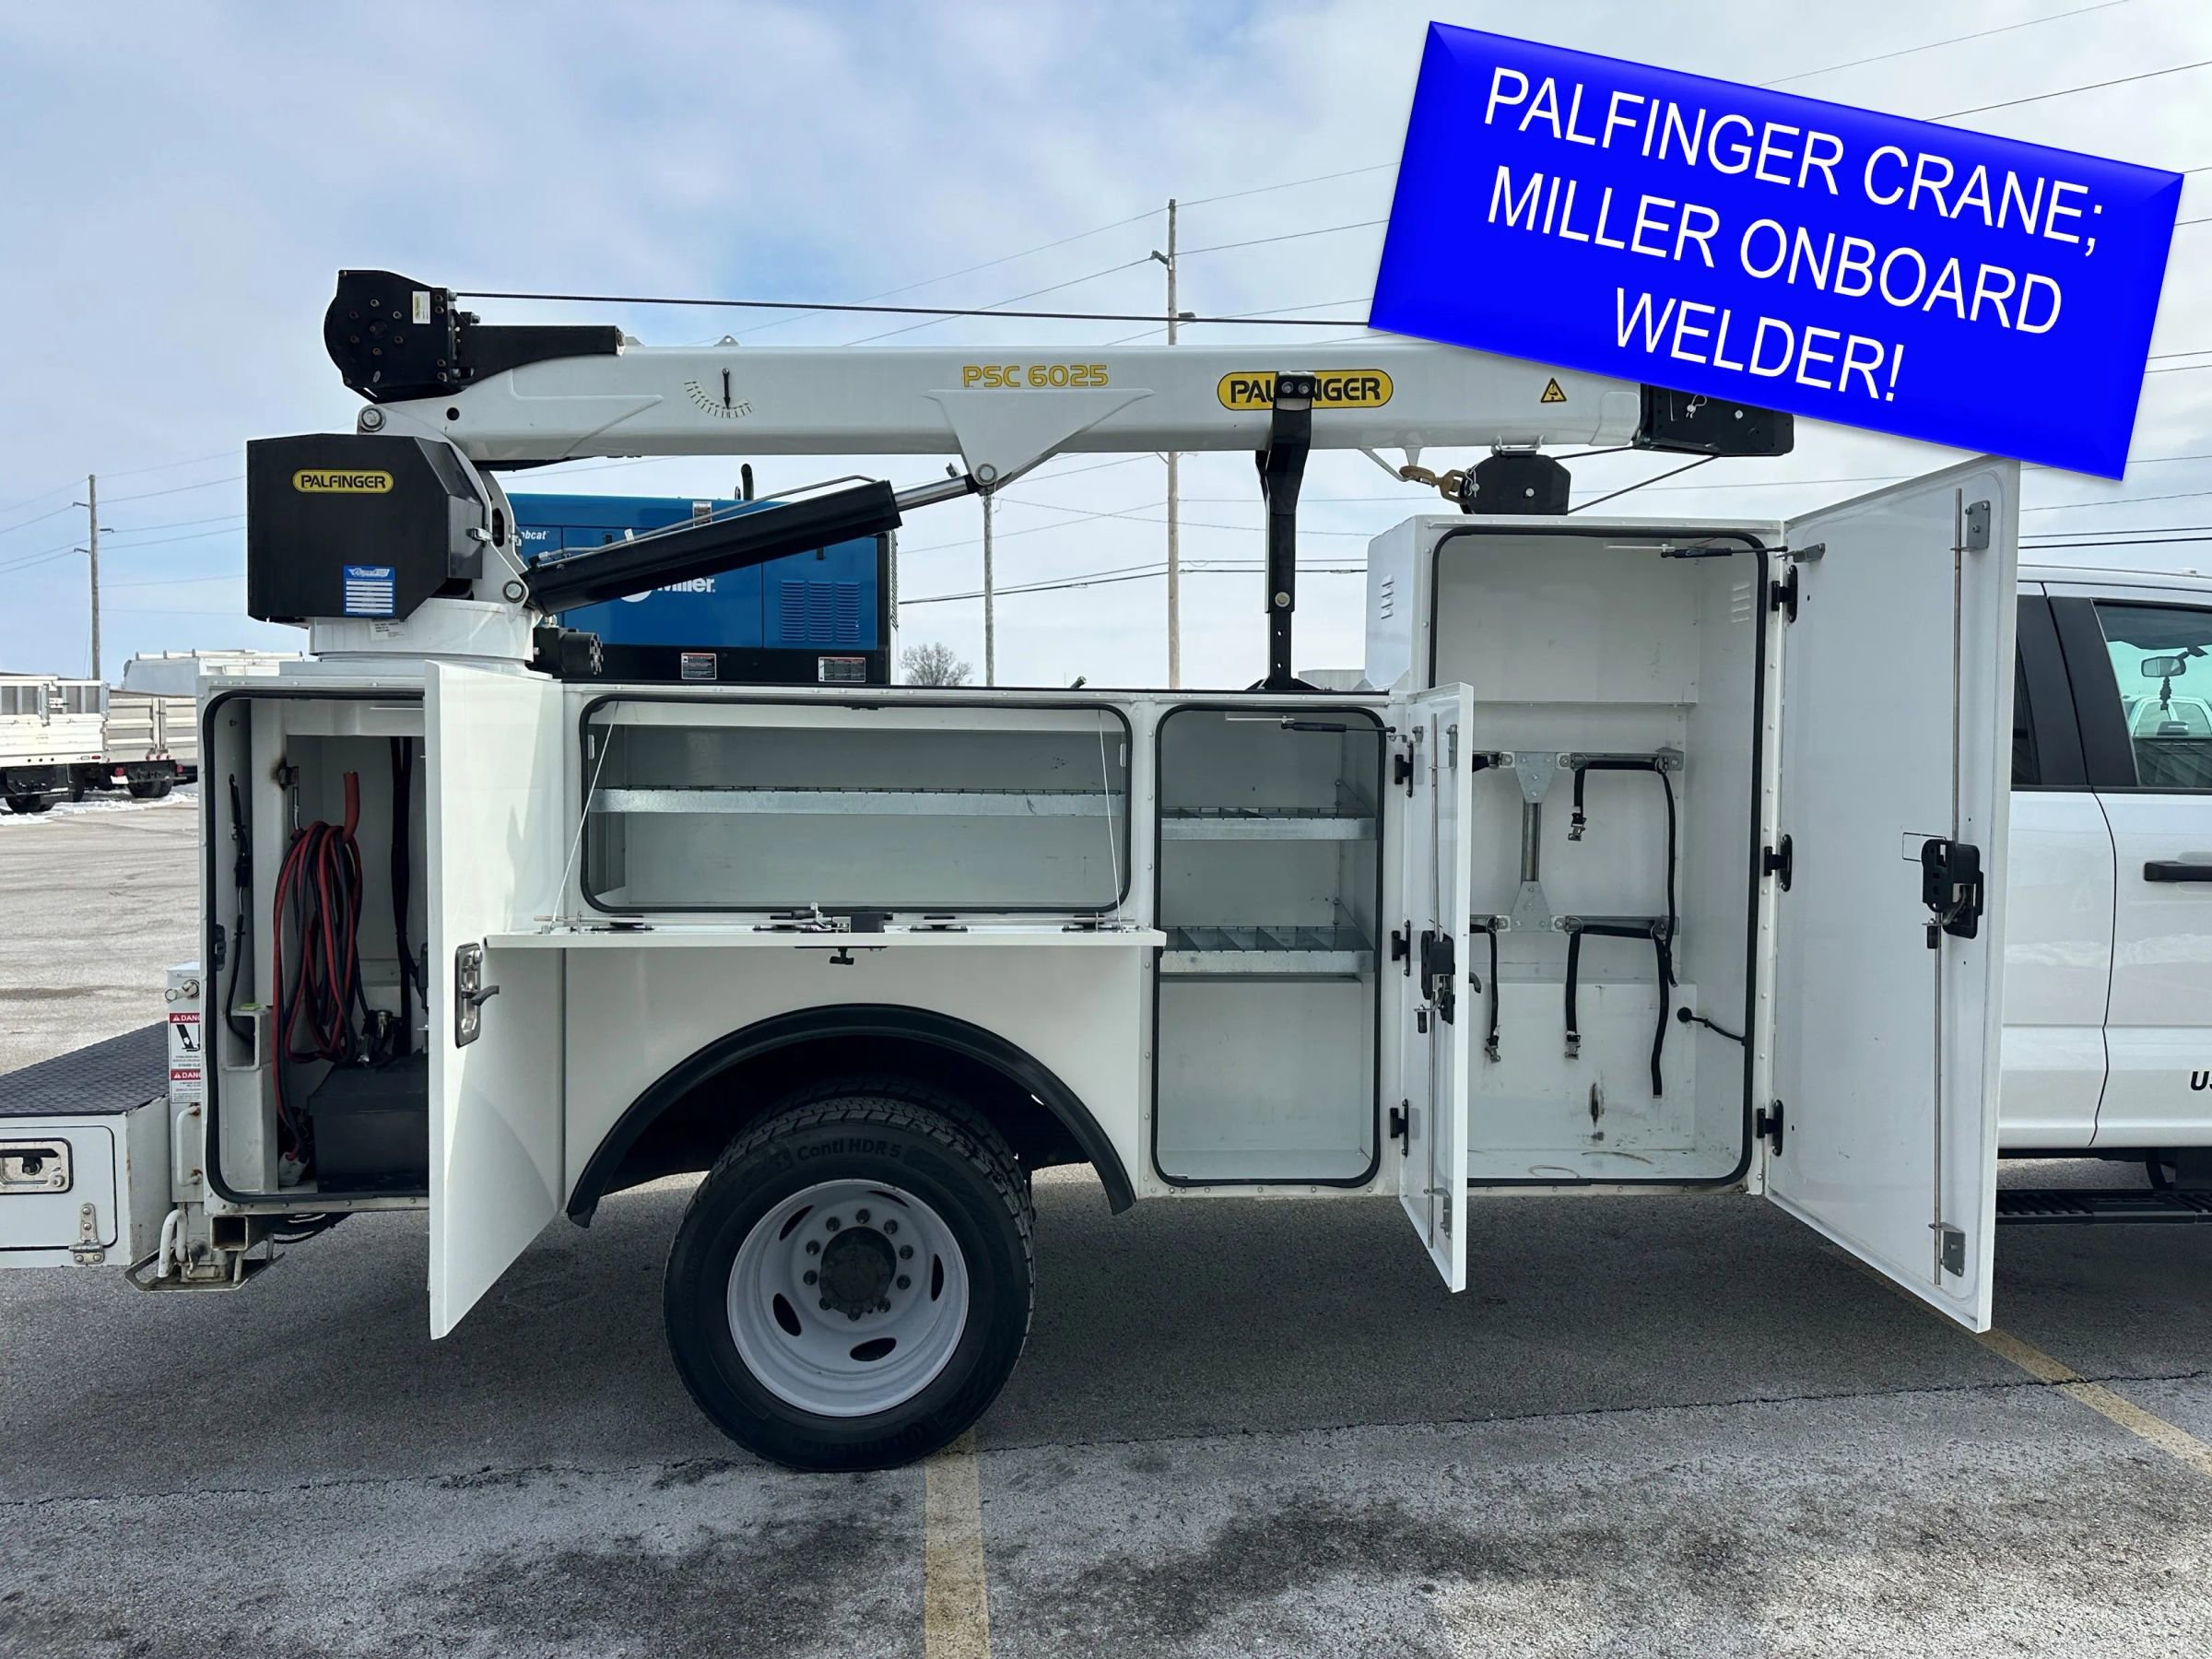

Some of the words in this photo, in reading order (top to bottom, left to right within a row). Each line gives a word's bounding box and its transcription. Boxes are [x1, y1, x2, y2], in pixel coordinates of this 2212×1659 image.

[962, 366, 1020, 387] PSC
[1028, 364, 1109, 387] 6025
[1230, 376, 1382, 404] PALNGER
[300, 475, 385, 488] PALFINGER
[2190, 1070, 2212, 1091] U
[849, 1138, 888, 1156] HDR
[889, 1144, 901, 1159] 5
